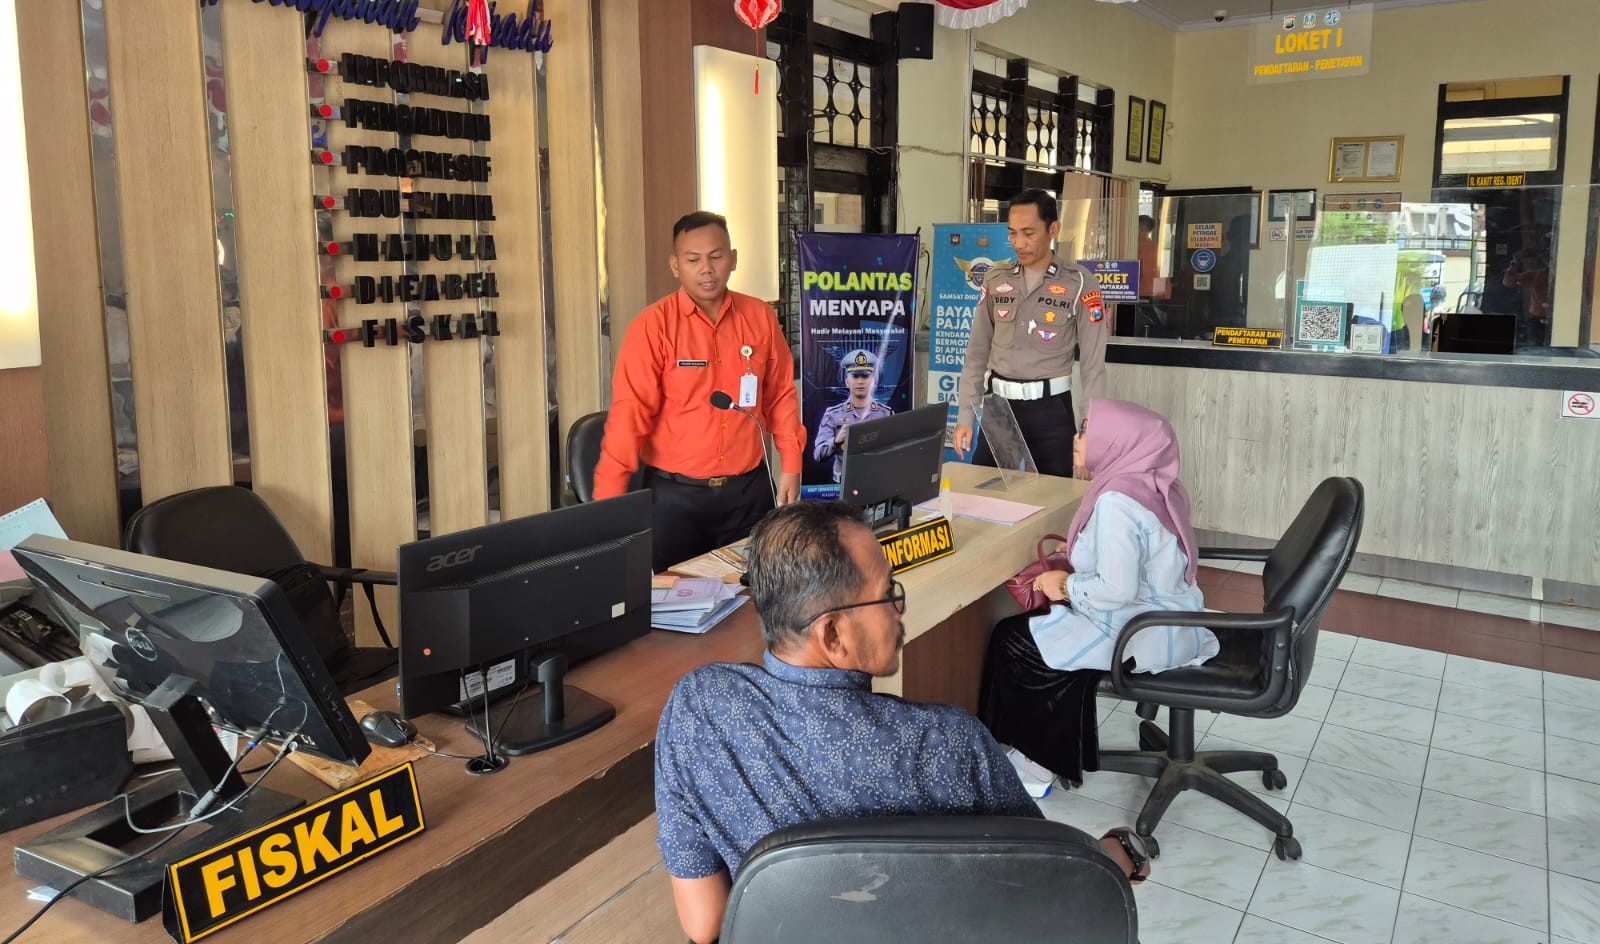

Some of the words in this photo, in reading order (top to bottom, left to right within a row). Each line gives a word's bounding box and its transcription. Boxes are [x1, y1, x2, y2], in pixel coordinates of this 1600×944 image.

[1275, 29, 1332, 54] LOKET
[1254, 61, 1309, 76] PENDAFTARAN
[1315, 55, 1363, 70] PENETAPAN
[342, 53, 490, 101] INFORMASI
[344, 98, 491, 141] PENGADUAN
[345, 145, 492, 182] PROGRESIF
[1506, 175, 1524, 186] IDENT
[347, 188, 400, 218] IBU
[403, 192, 496, 221] HAMIL
[353, 233, 497, 261] MANULA
[803, 271, 913, 291] POLANTAS
[1094, 273, 1129, 284] OKET
[809, 299, 906, 316] MENYAPA
[1038, 296, 1070, 309] POLRI
[361, 310, 501, 348] FISKAL
[935, 317, 974, 330] PAJA
[1216, 329, 1266, 338] PENDAFTARAN
[1228, 336, 1269, 345] PENETAPAN
[938, 375, 960, 392] G
[938, 392, 959, 402] BIA
[881, 524, 951, 569] INFORMASI
[426, 545, 483, 572] acer
[201, 788, 404, 919] FISKAL
